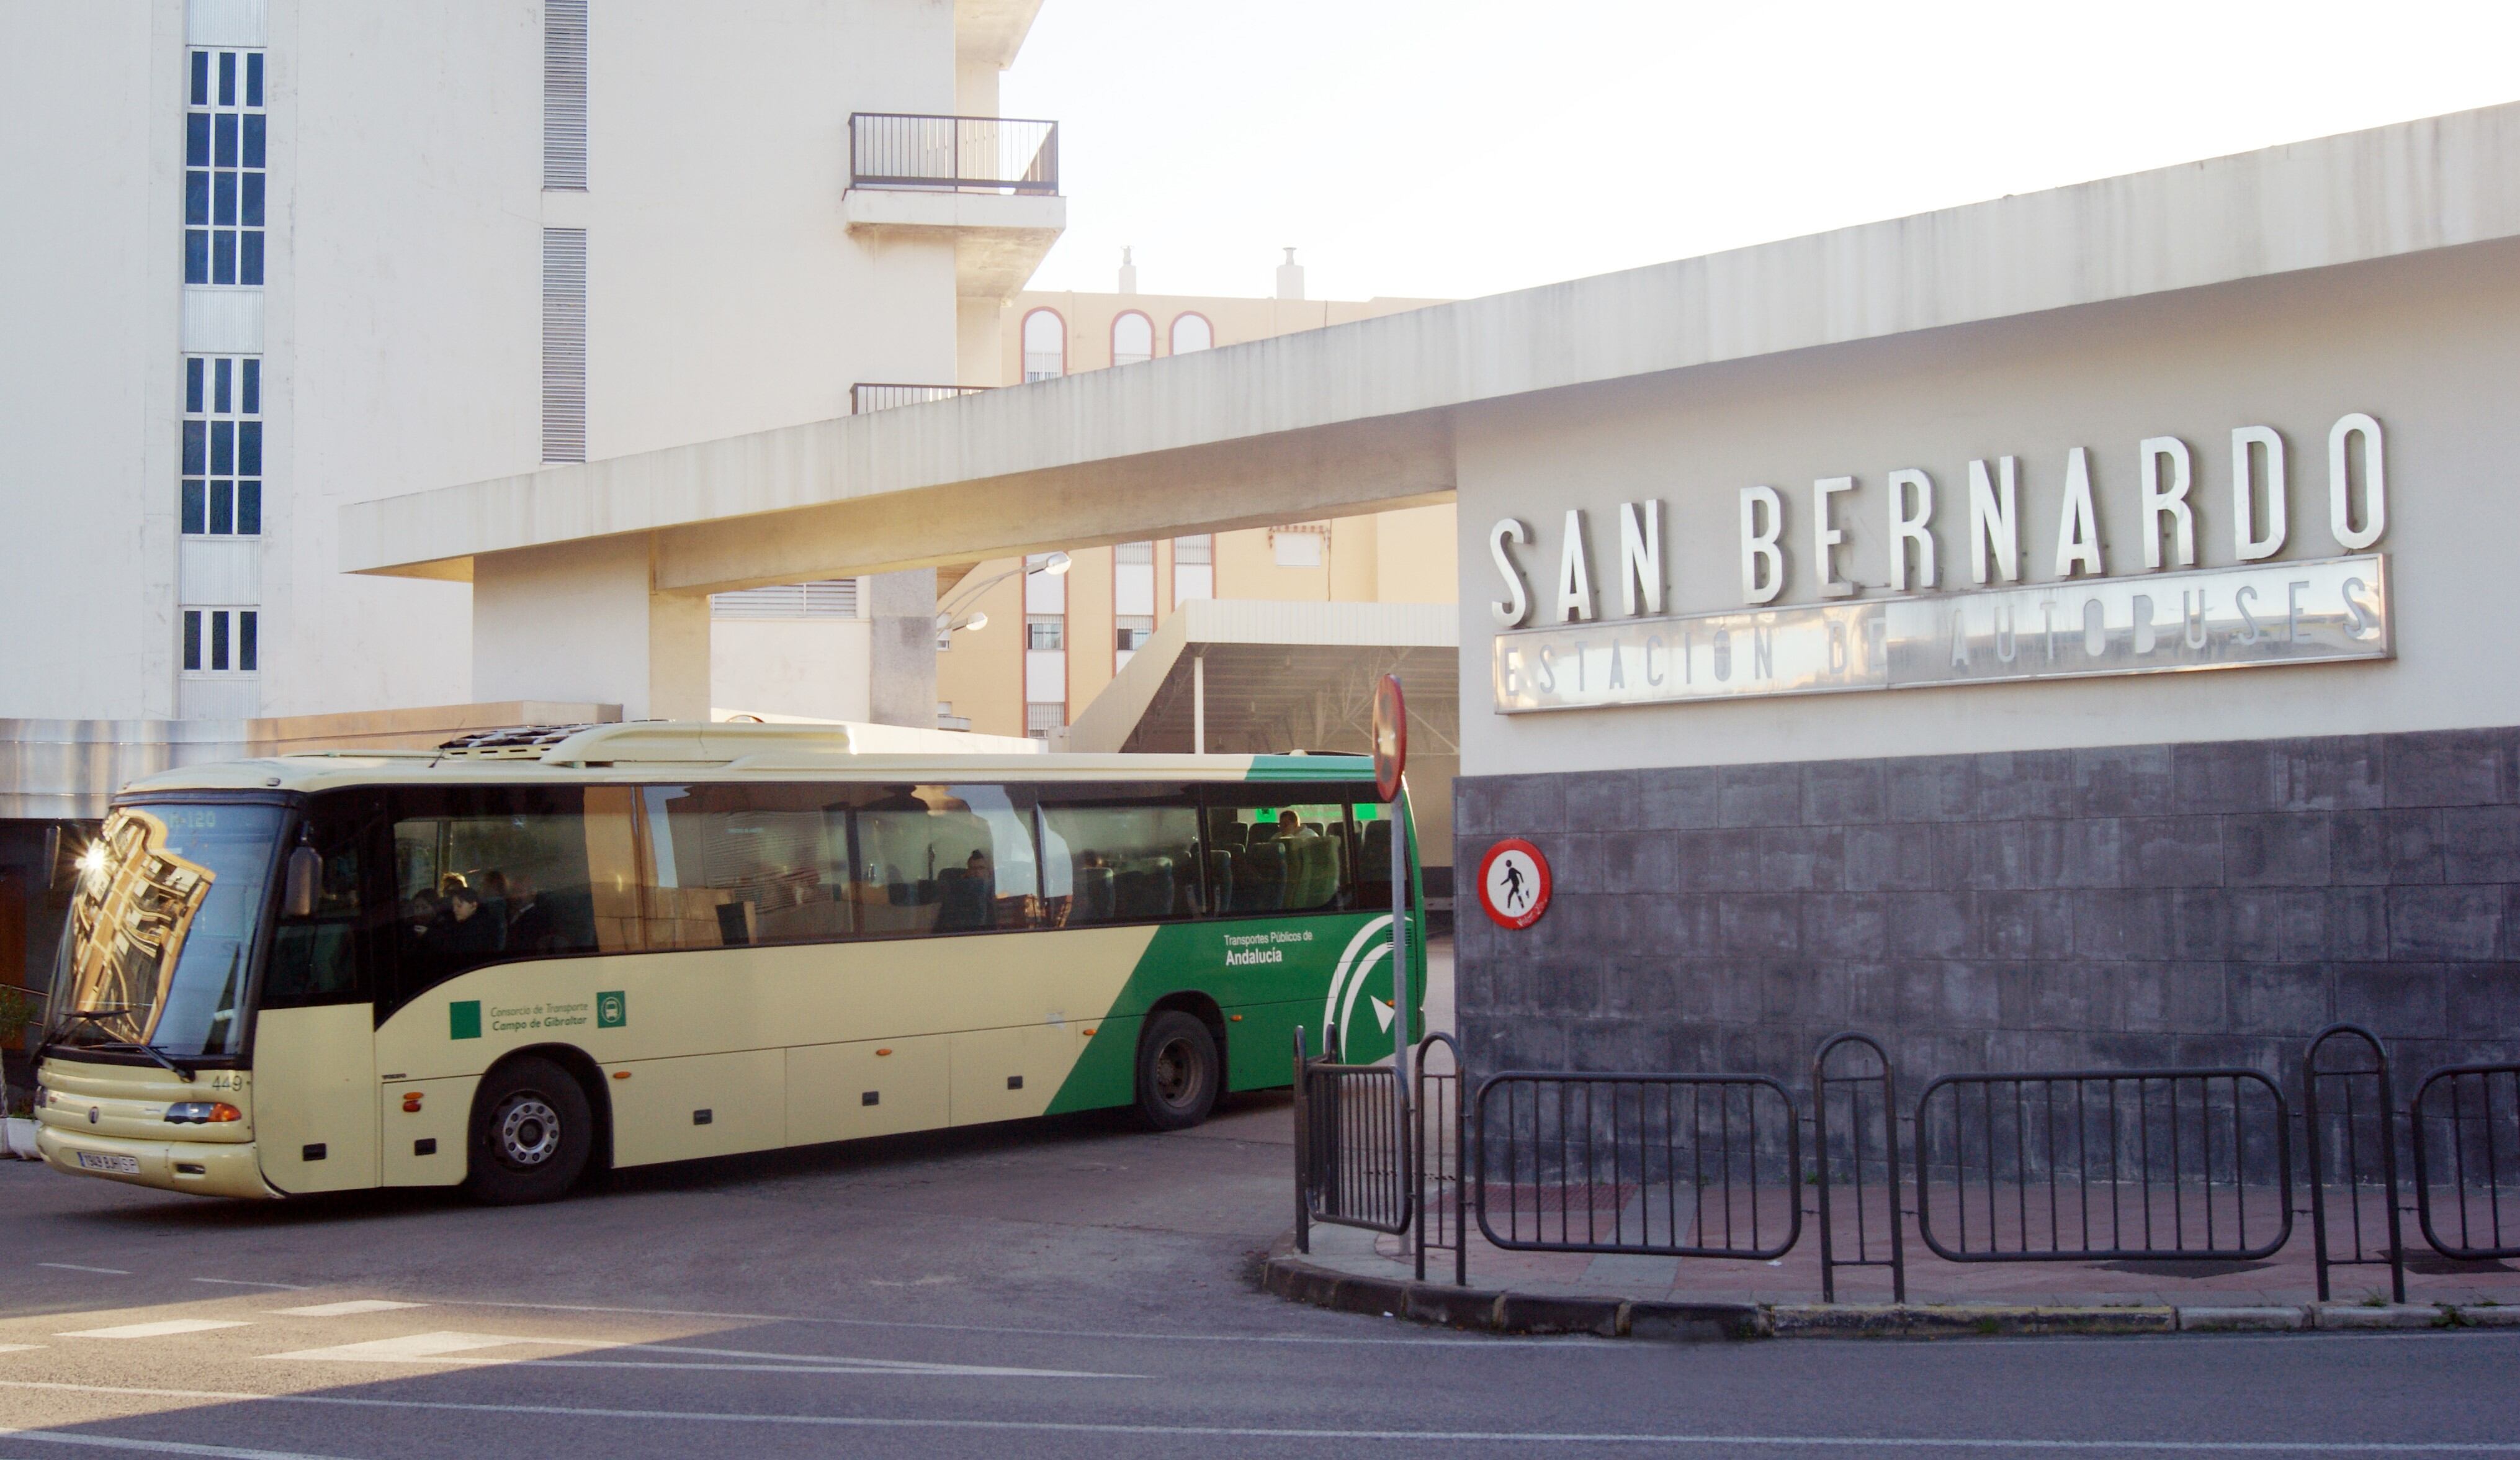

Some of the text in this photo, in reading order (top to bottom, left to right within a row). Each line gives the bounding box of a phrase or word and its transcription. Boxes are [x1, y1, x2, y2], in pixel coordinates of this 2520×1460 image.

[1489, 412, 2385, 628] SAN BERNARDO
[1827, 616, 1887, 675] DE
[1950, 576, 2379, 667] AUTOBUSES
[1224, 931, 1313, 946] Transportes Públicos de
[1226, 947, 1283, 966] Andalucía
[491, 1003, 588, 1017] Consorcio de Transporte
[493, 1017, 586, 1031] Campo de Gibraltar
[212, 1075, 242, 1091] 449
